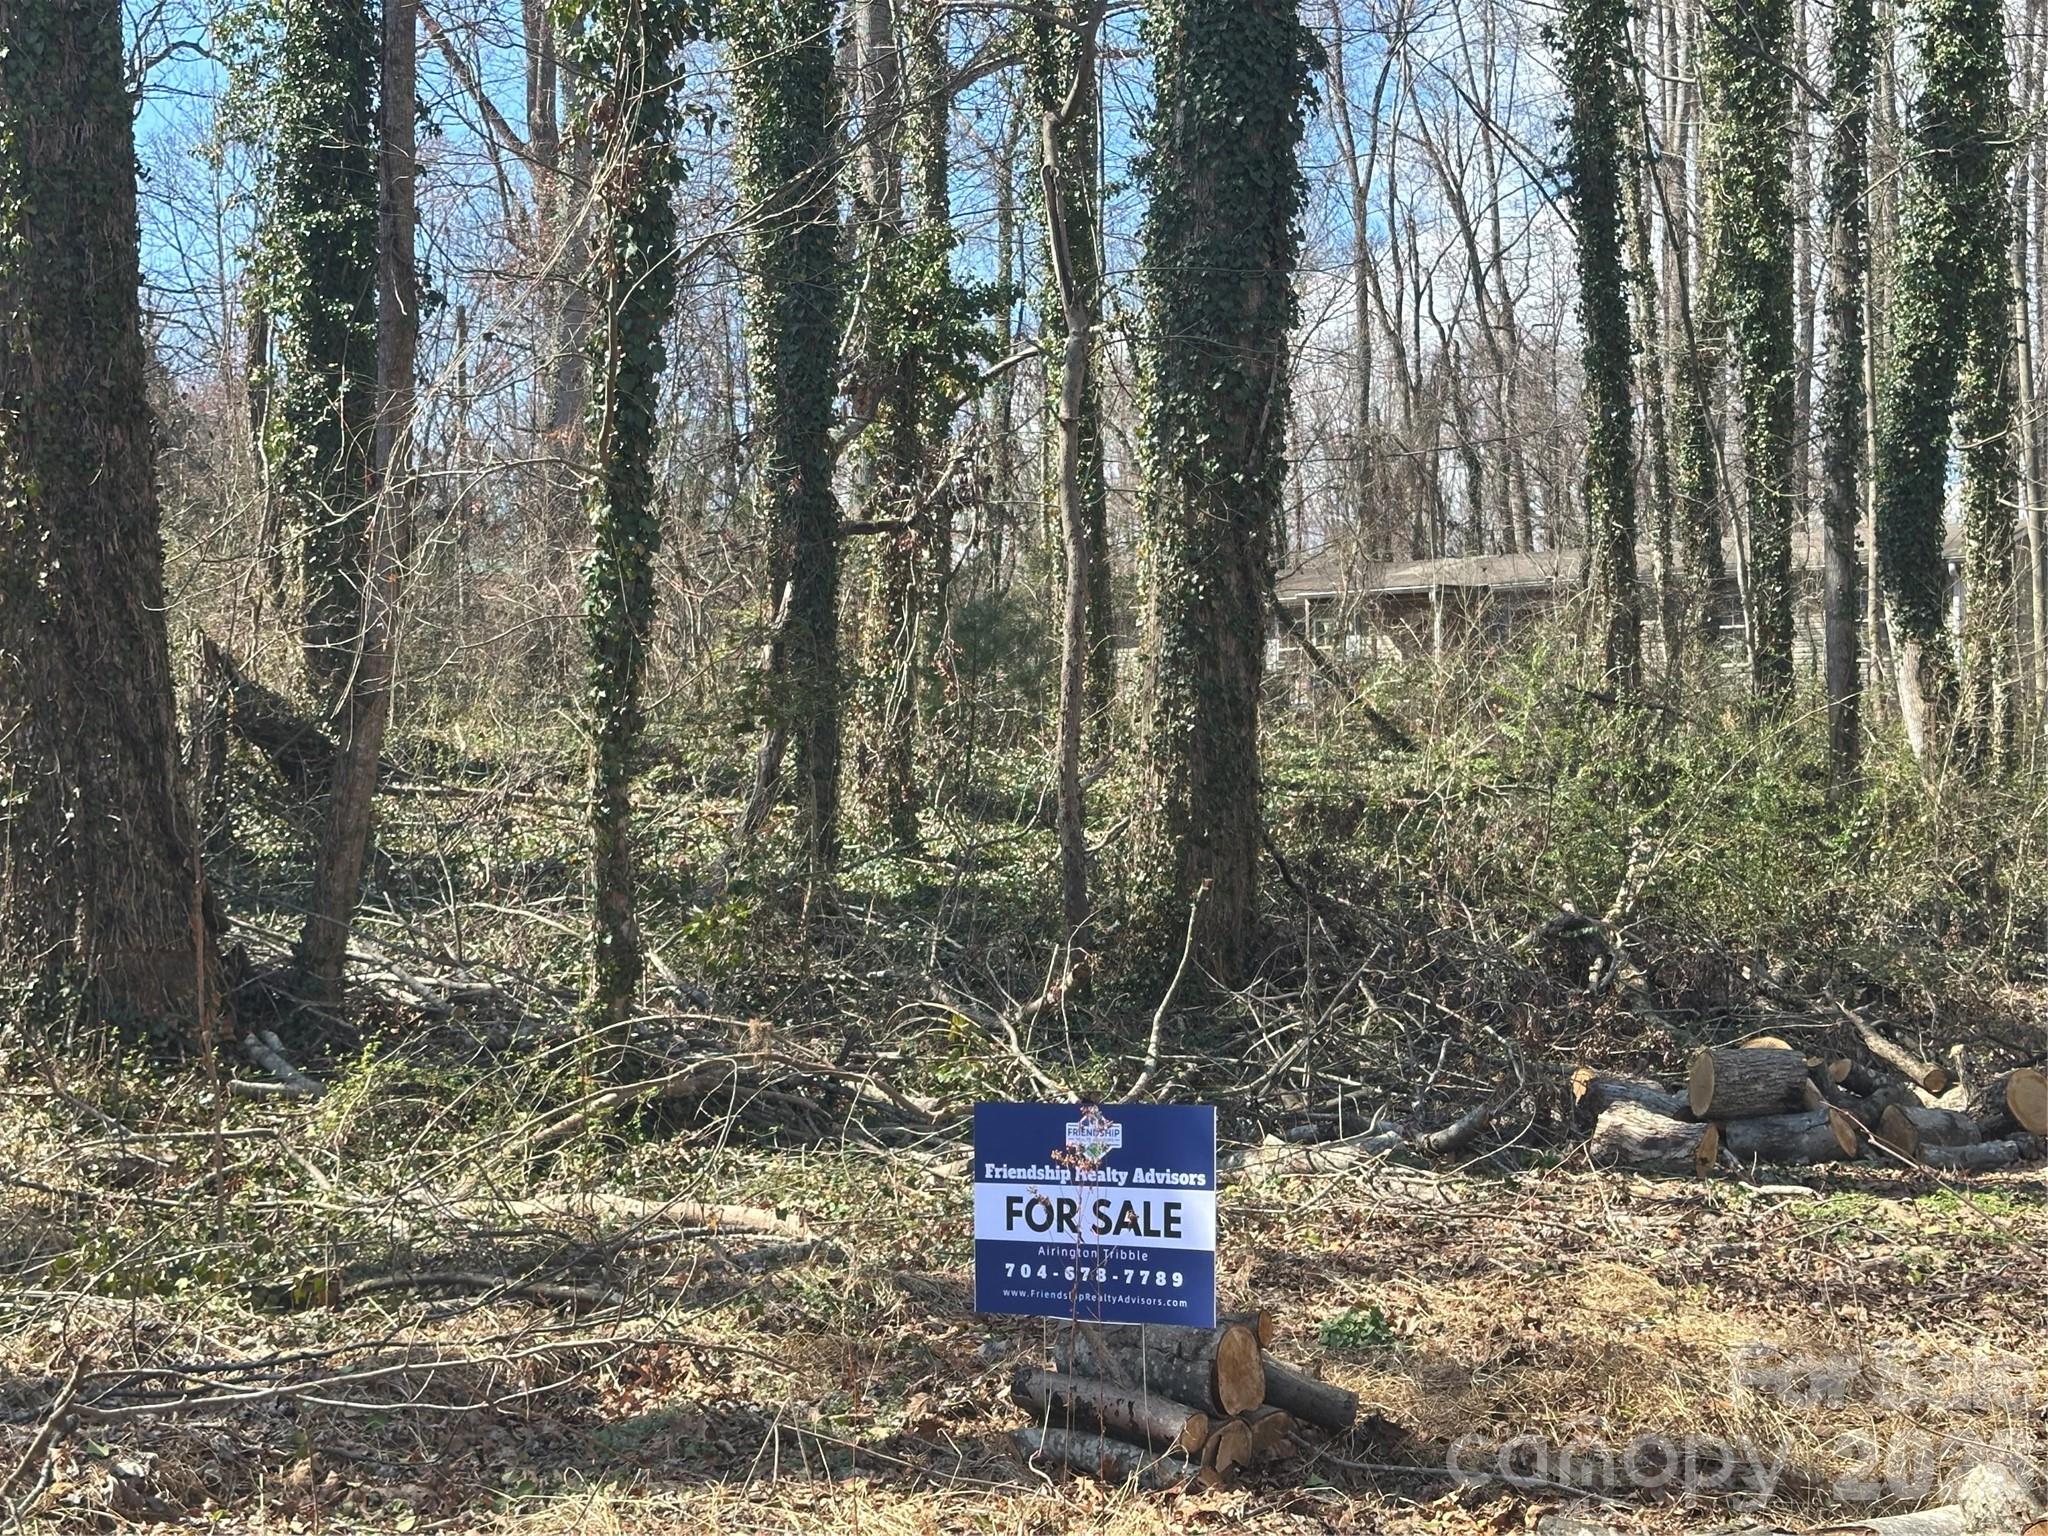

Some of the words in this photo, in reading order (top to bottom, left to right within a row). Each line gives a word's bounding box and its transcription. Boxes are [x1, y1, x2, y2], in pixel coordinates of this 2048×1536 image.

[1067, 1127, 1120, 1138] FRIENDSHIP
[985, 1163, 1071, 1184] Friendship
[1075, 1166, 1128, 1187] Realty
[1132, 1167, 1206, 1186] Advisors
[1006, 1196, 1078, 1234] FOR
[1092, 1200, 1182, 1239] SALE
[1038, 1246, 1097, 1260] Airington
[1103, 1249, 1148, 1262] Tribble
[1005, 1263, 1184, 1288] 704-678-7789
